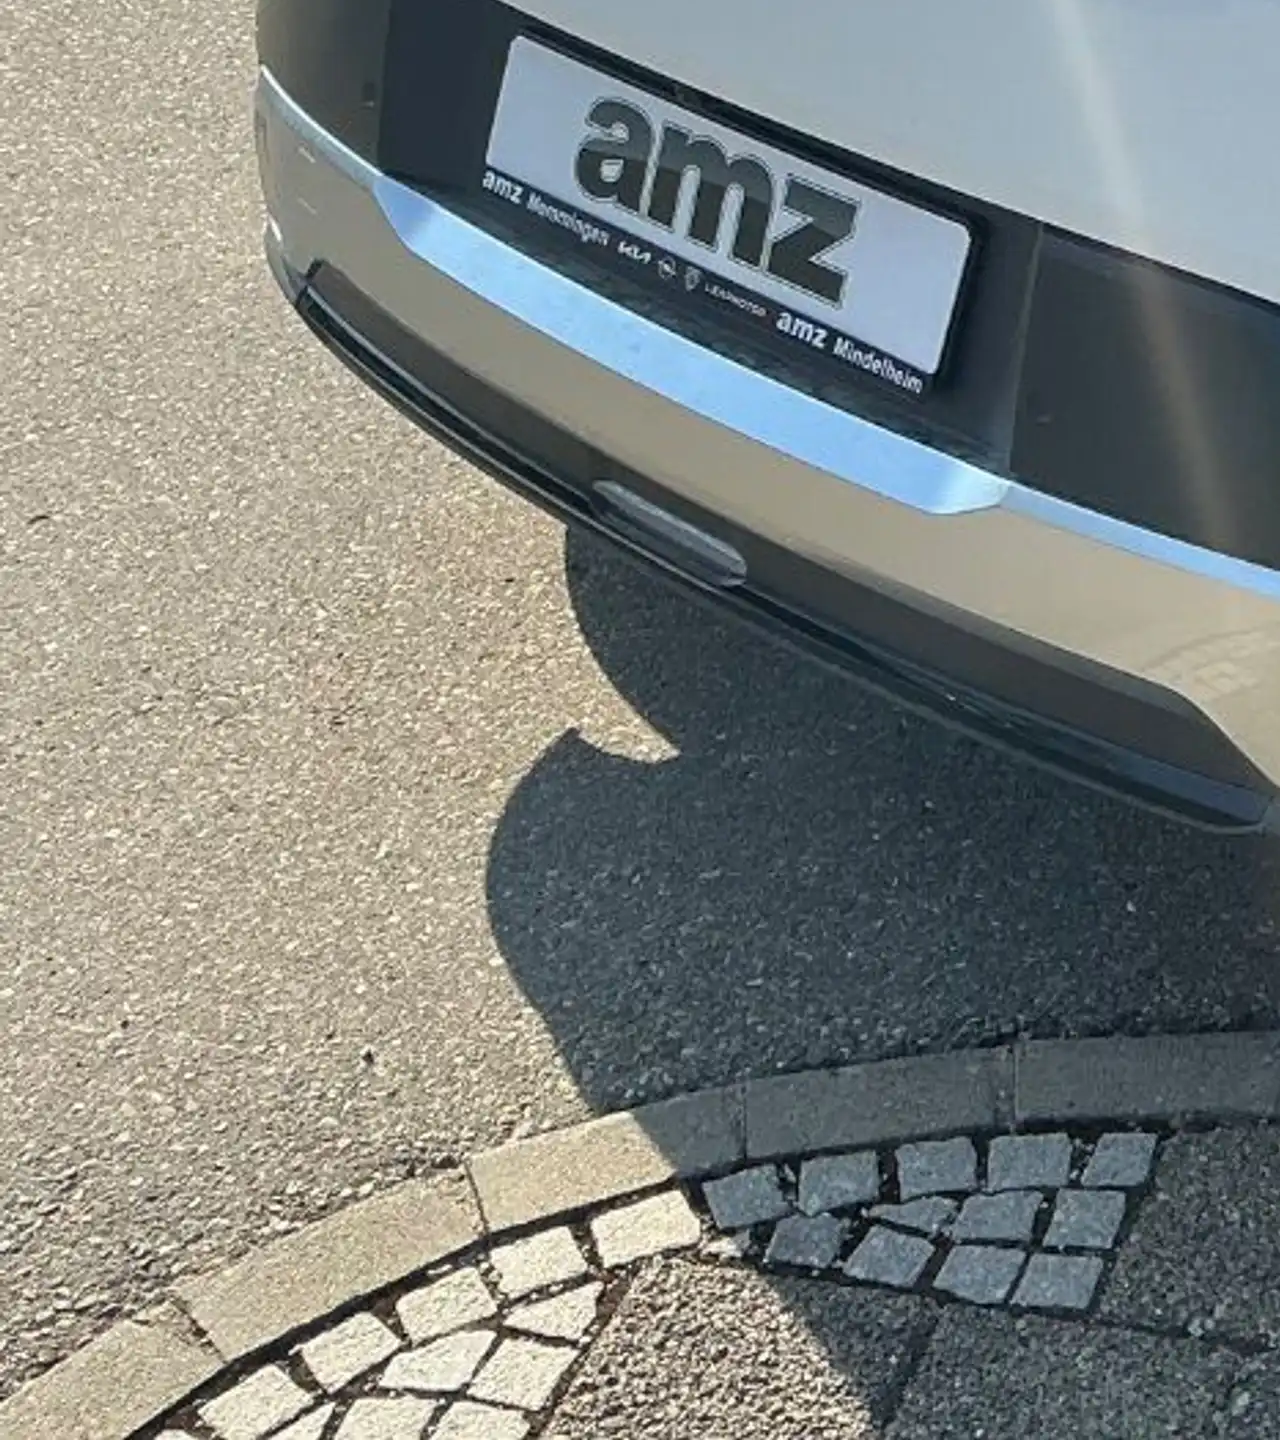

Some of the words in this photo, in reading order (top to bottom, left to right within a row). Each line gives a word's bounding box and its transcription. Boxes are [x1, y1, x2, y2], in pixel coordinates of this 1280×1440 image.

[482, 169, 524, 205] amz
[775, 311, 828, 350] amz
[832, 336, 924, 395] Mindelheim
[575, 96, 861, 309] amz
